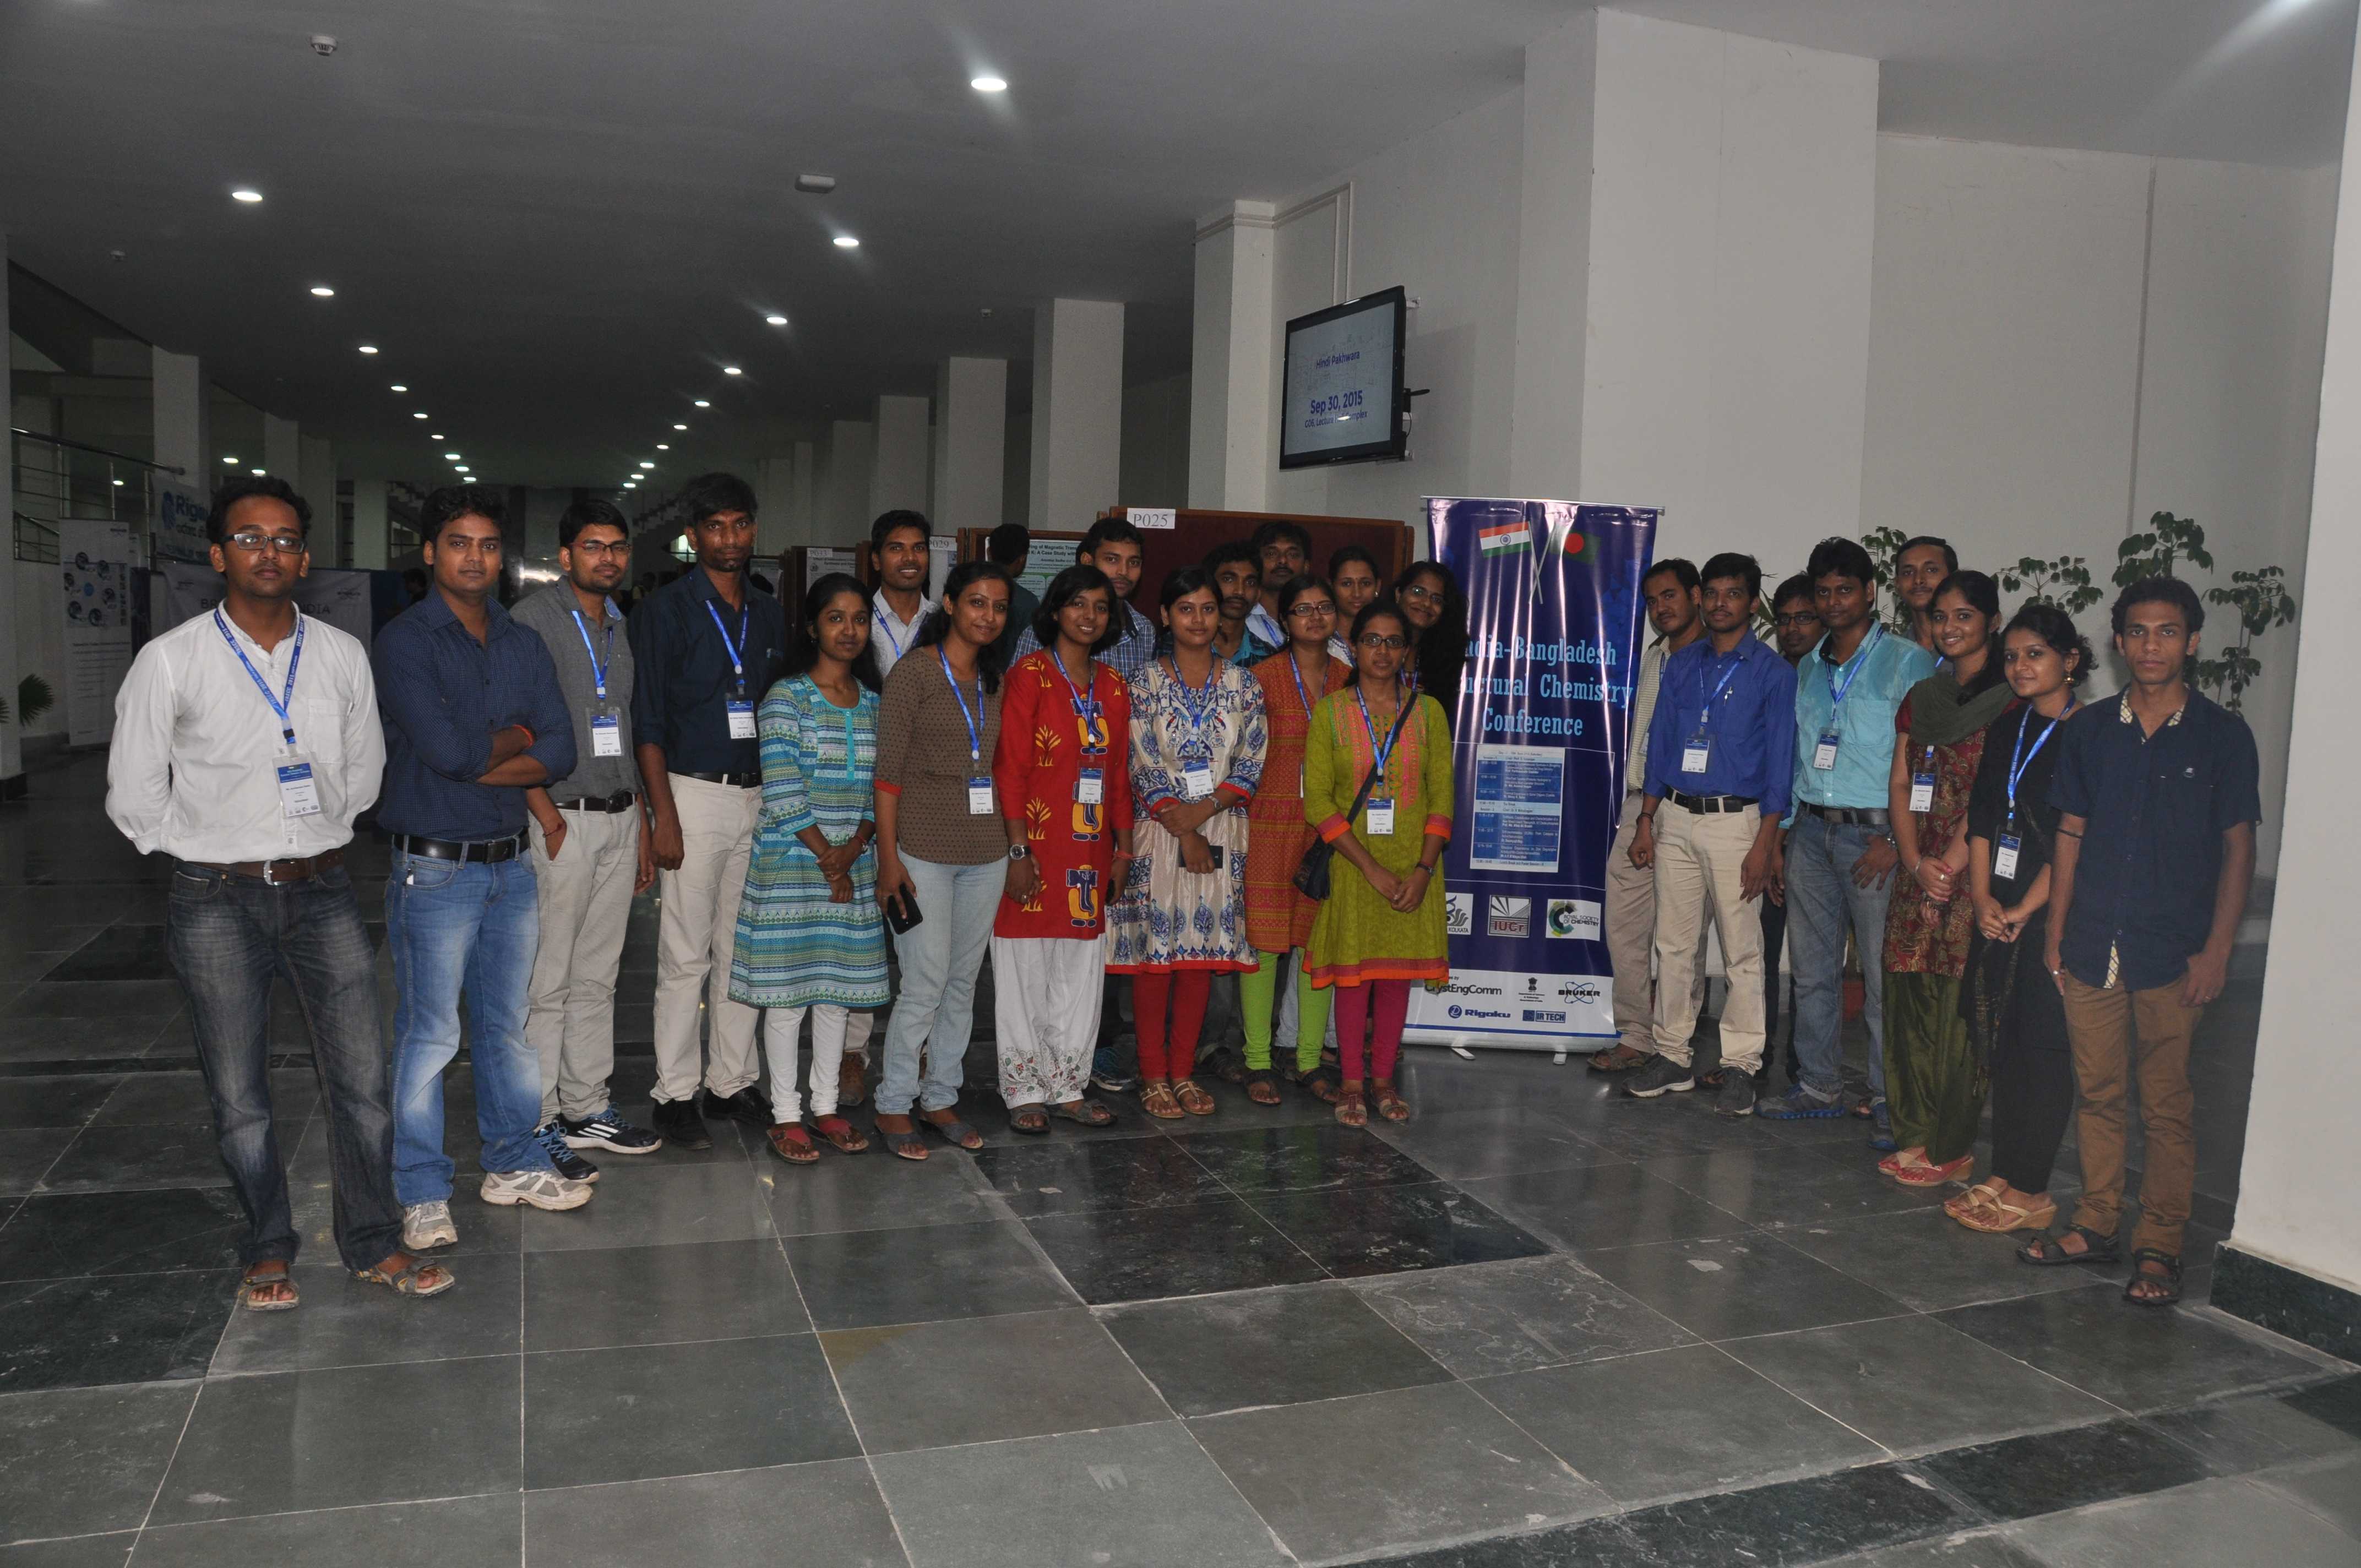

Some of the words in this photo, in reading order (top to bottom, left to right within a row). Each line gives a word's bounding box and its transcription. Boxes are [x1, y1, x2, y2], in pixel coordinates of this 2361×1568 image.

[1316, 356, 1330, 369] Hindi
[1331, 351, 1361, 364] Pakhwara
[1310, 399, 1326, 416] Sep
[1328, 395, 1341, 411] 30,
[1342, 390, 1363, 409] 2015
[1133, 513, 1168, 527] P025
[1465, 634, 1617, 666] ndia-Bangladesh
[1540, 674, 1634, 709] Chemistry
[1483, 708, 1583, 736] Conference
[1494, 920, 1525, 932] IUCr
[1424, 983, 1502, 996] CystEngComm
[1465, 1009, 1511, 1019] Rigaku
[1545, 1012, 1565, 1021] TECH
